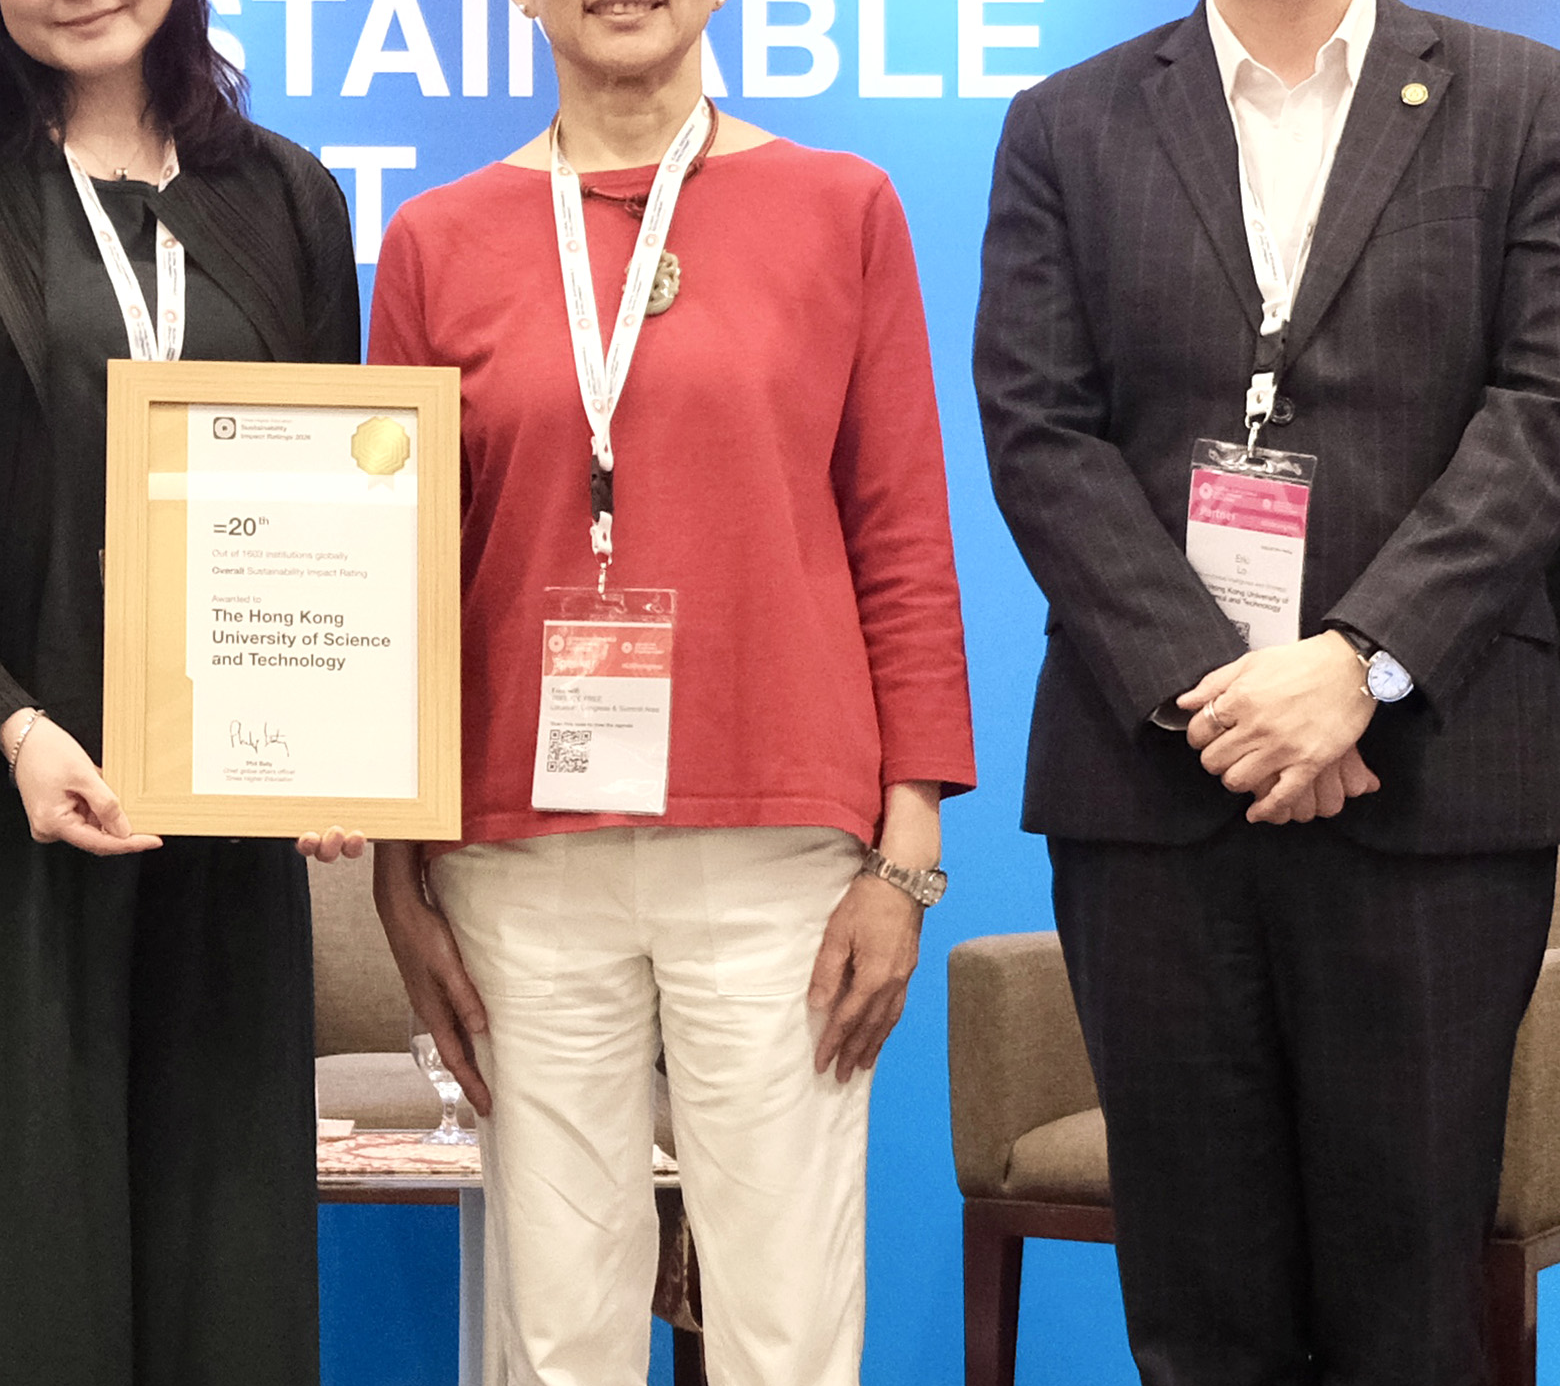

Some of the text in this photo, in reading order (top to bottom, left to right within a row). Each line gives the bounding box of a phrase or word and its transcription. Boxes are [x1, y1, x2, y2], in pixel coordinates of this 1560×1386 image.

[211, 548, 228, 558] Out
[231, 549, 240, 558] of
[211, 566, 368, 580] Overall Sustainability Impact Rating
[211, 594, 262, 604] Awarded to
[212, 608, 344, 628] The Hong Kong
[212, 630, 391, 648] University of Science
[212, 652, 346, 671] and Technology
